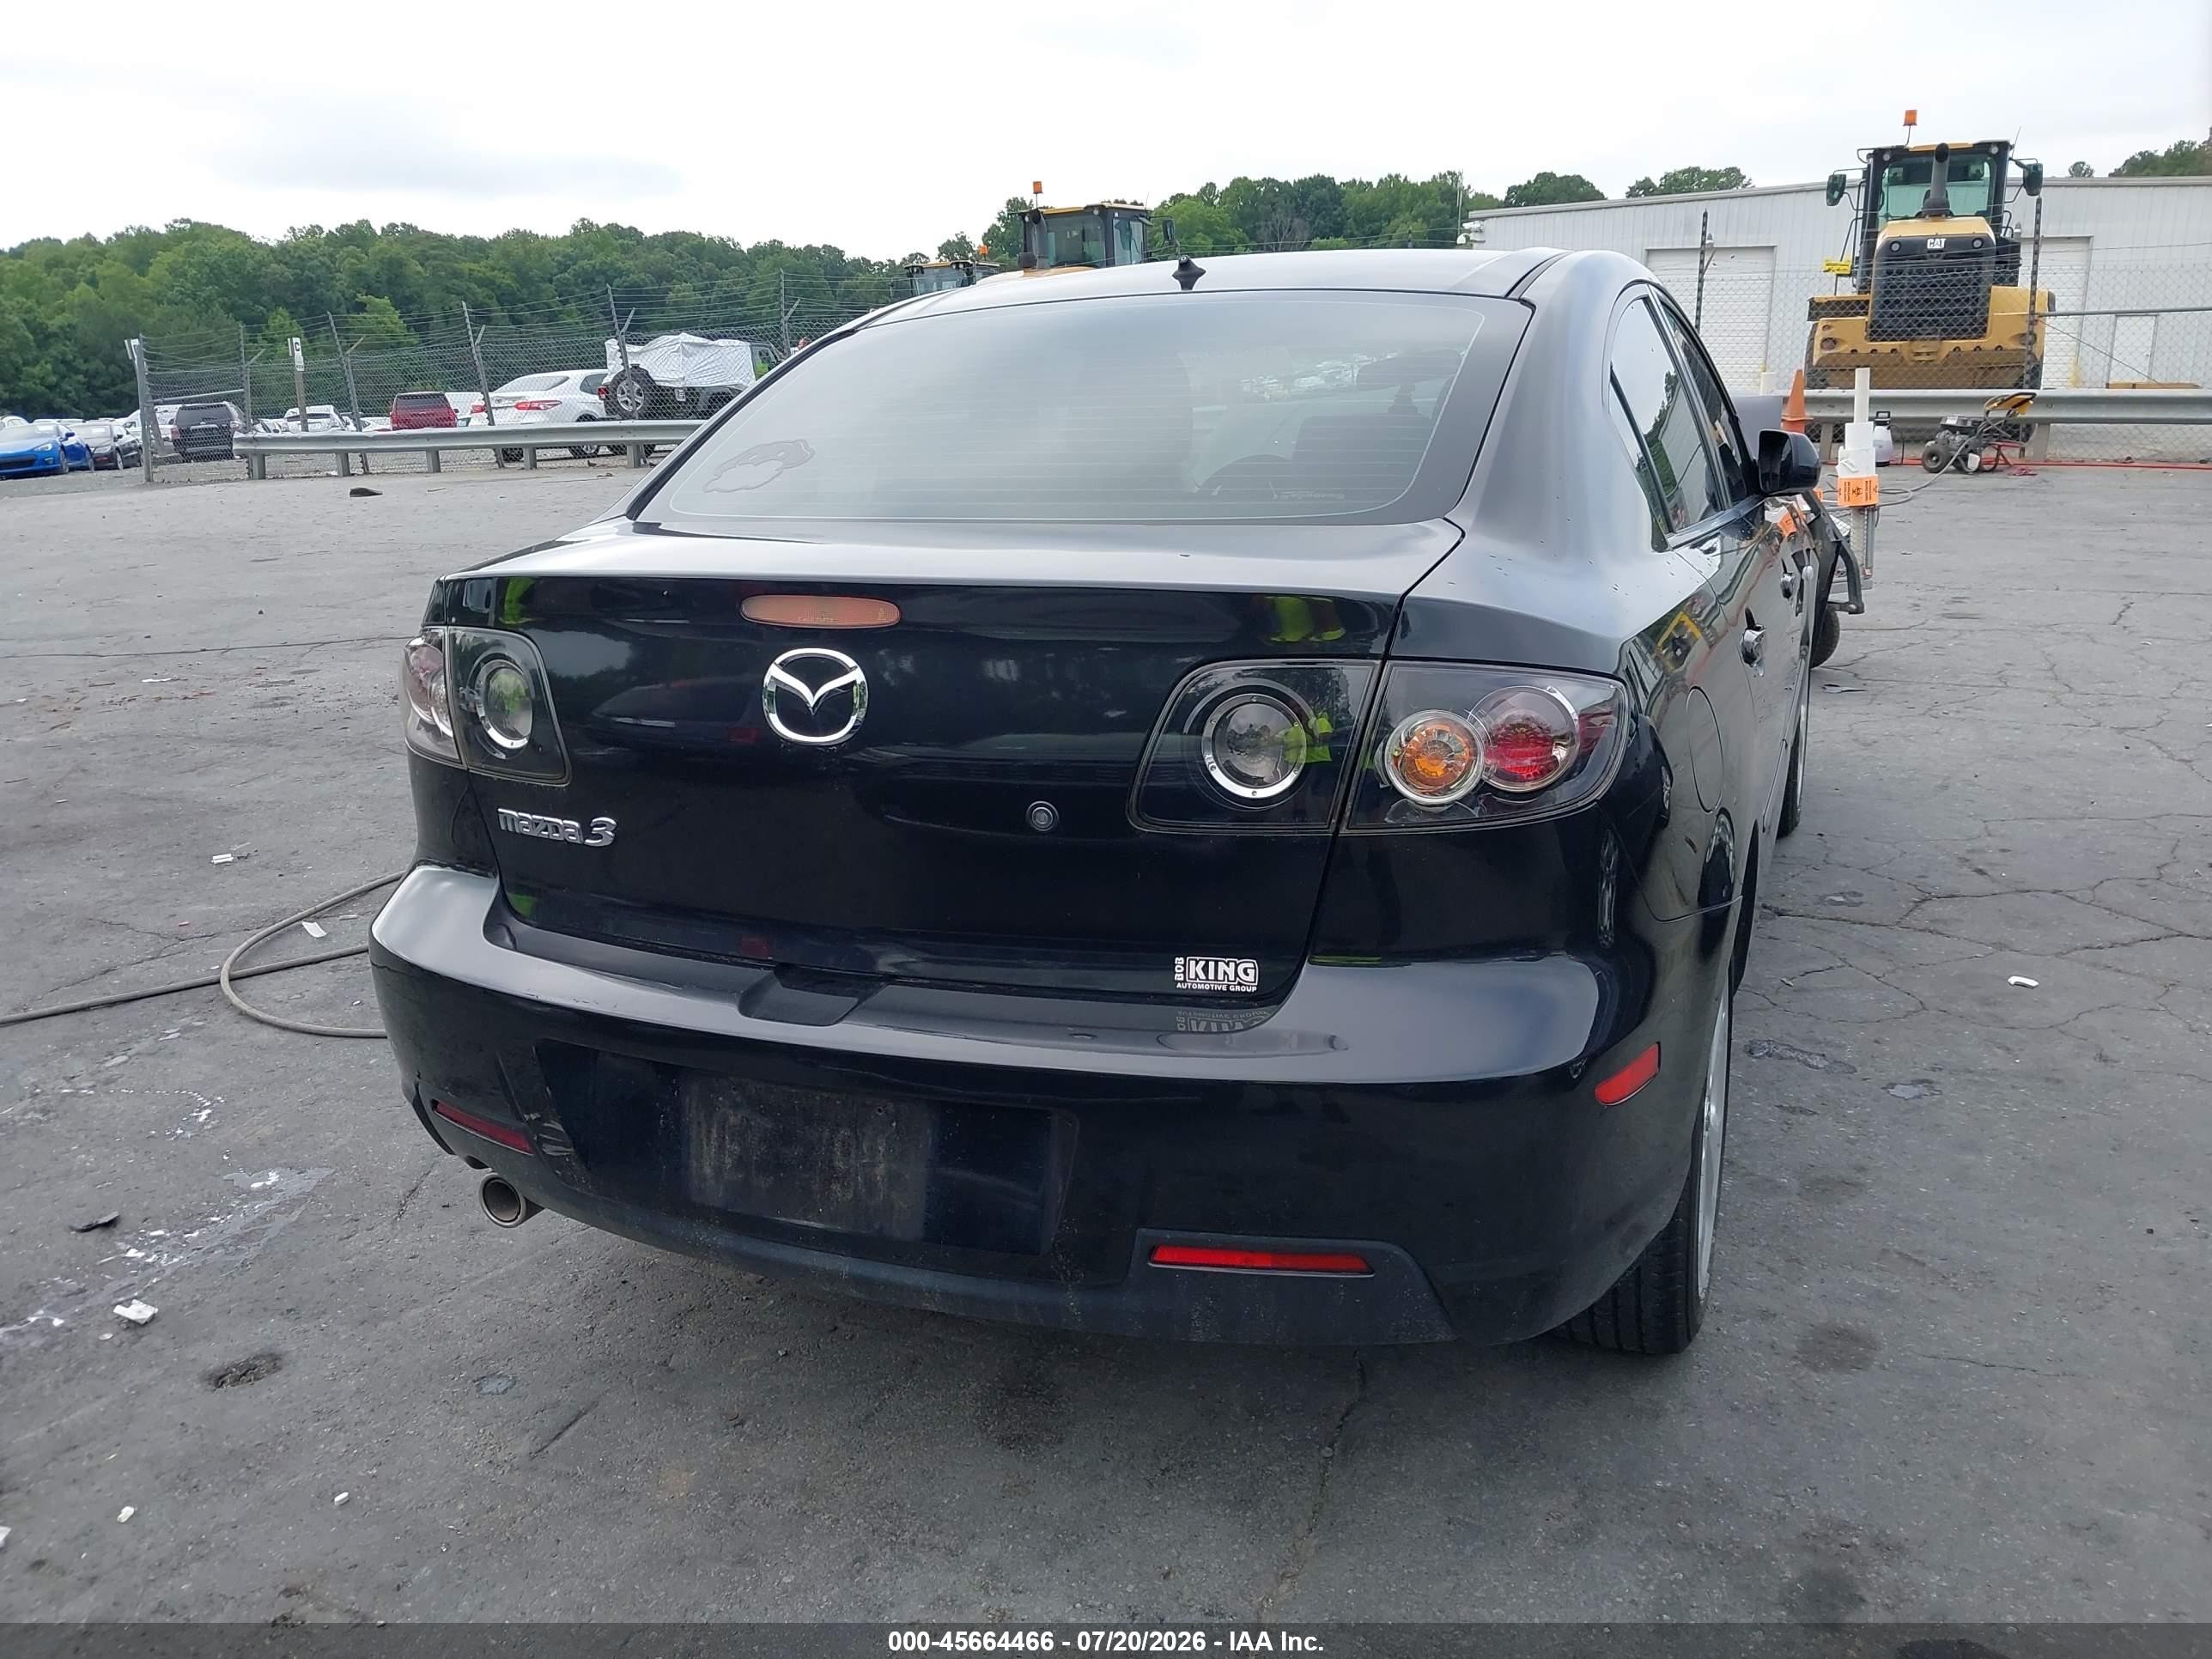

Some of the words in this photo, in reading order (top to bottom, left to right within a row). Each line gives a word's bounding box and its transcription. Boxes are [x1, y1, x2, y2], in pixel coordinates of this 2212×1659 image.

[1928, 238, 1946, 249] CAT
[584, 817, 617, 847] 3
[1174, 957, 1184, 981] BOB
[1188, 959, 1256, 982] KING
[1176, 981, 1227, 991] AUTOMOTIVE
